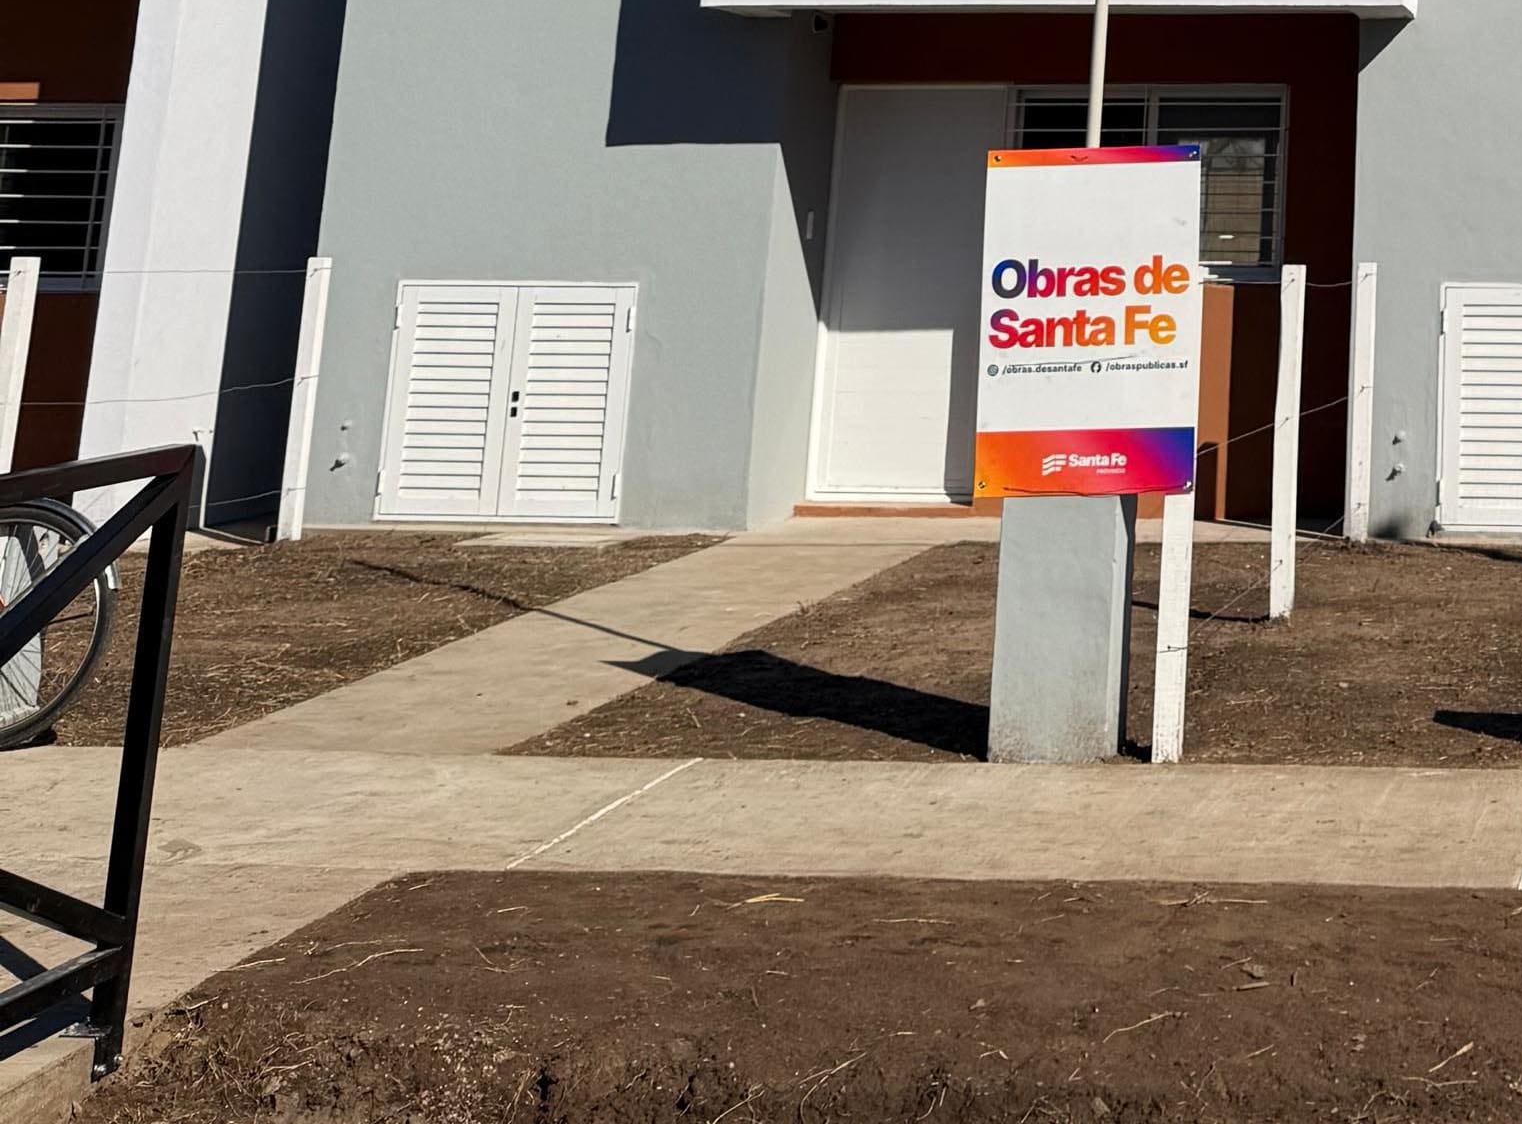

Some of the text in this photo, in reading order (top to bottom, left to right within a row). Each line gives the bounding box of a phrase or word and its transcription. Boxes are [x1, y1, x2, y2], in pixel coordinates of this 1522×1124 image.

[991, 255, 1190, 300] Obras de
[988, 305, 1177, 350] Santa Fe
[1068, 452, 1128, 468] Santa Fe
